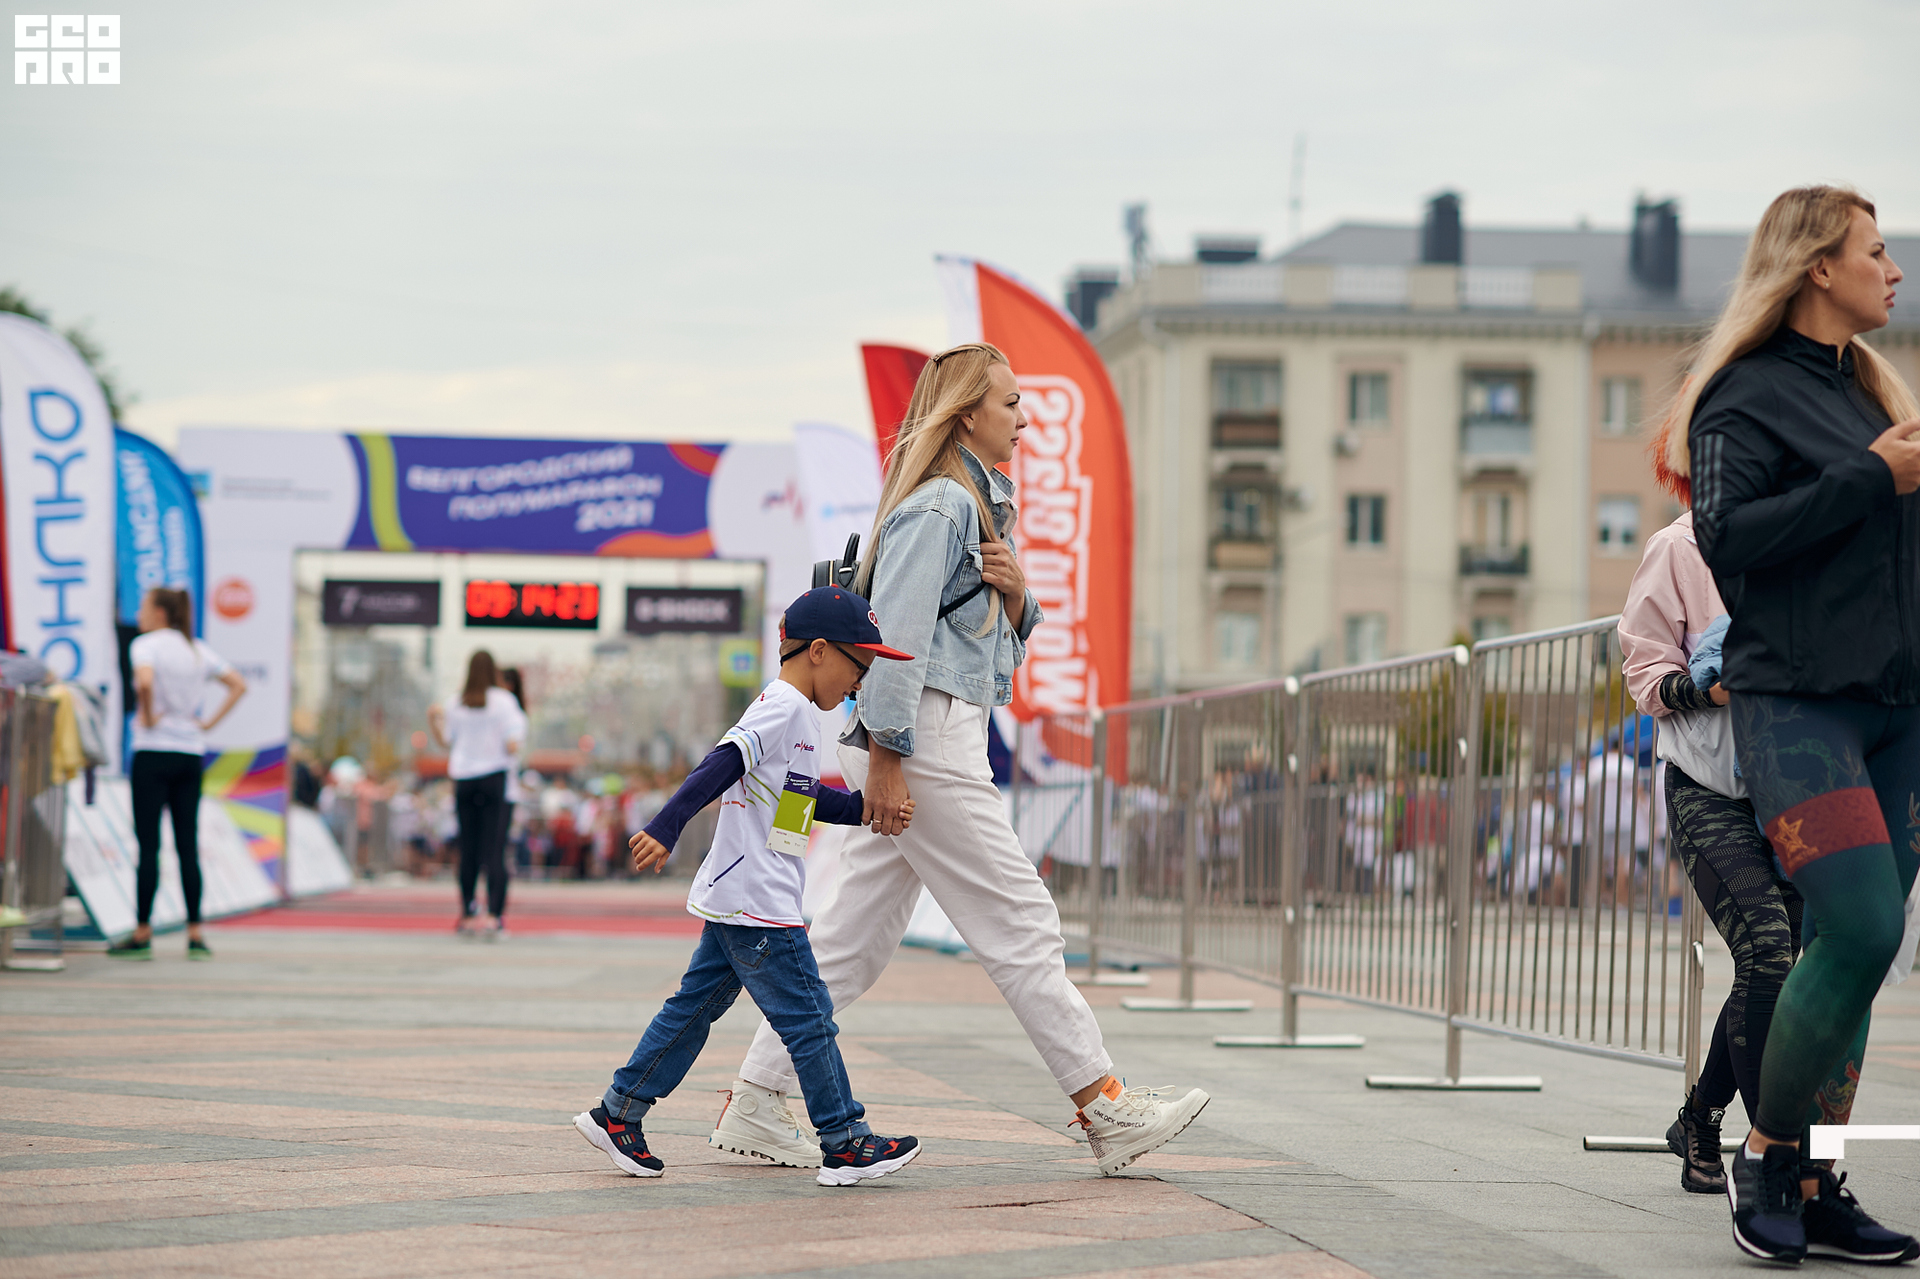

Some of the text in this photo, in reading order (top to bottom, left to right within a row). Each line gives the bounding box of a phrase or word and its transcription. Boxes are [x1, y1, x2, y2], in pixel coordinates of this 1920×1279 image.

[406, 445, 633, 491] БЕЛГОРОДСКИЙ
[448, 472, 662, 520] ПОЛУМАРАФОН
[575, 499, 655, 531] 2021
[1093, 1109, 1116, 1124] UNLOCK
